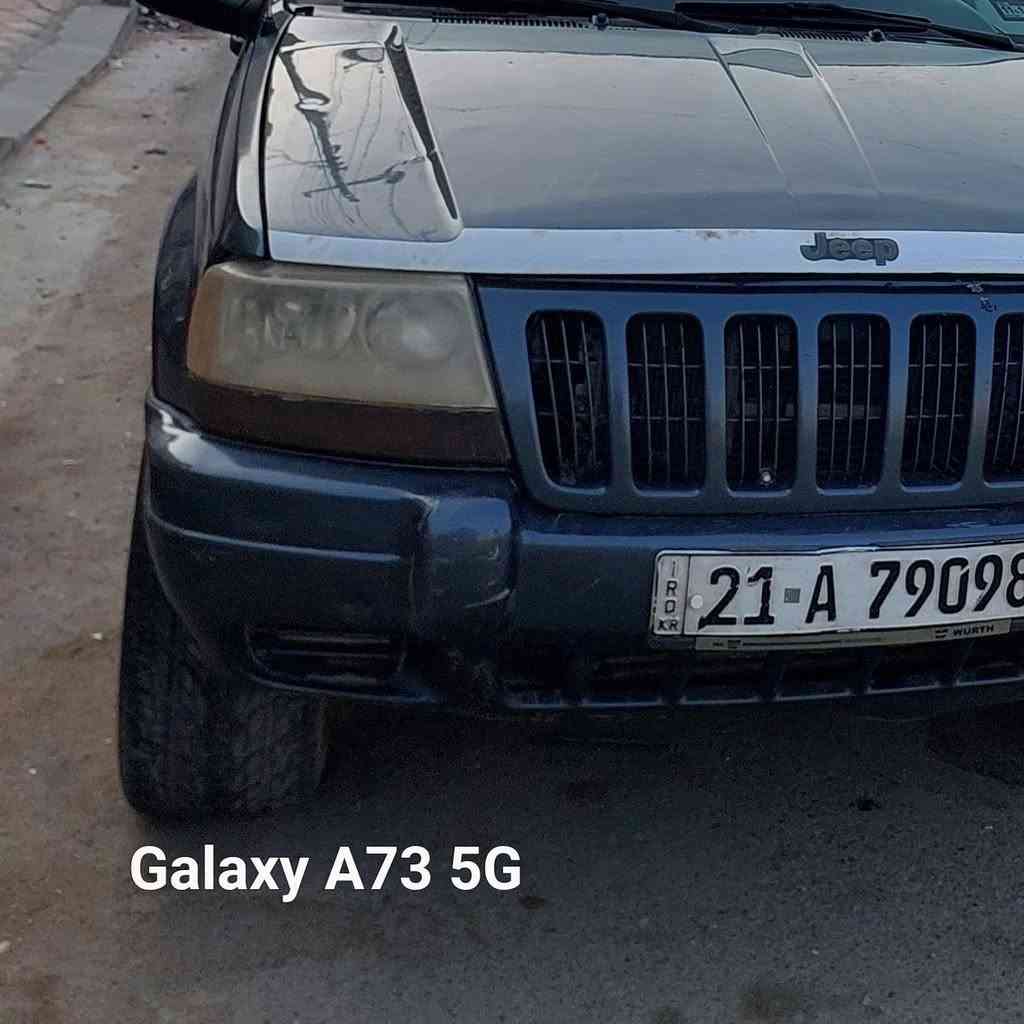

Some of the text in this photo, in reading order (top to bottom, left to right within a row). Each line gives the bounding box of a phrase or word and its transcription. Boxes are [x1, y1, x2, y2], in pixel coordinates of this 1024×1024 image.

[800, 232, 899, 266] Jeep
[698, 566, 774, 629] 21
[805, 565, 836, 623] A
